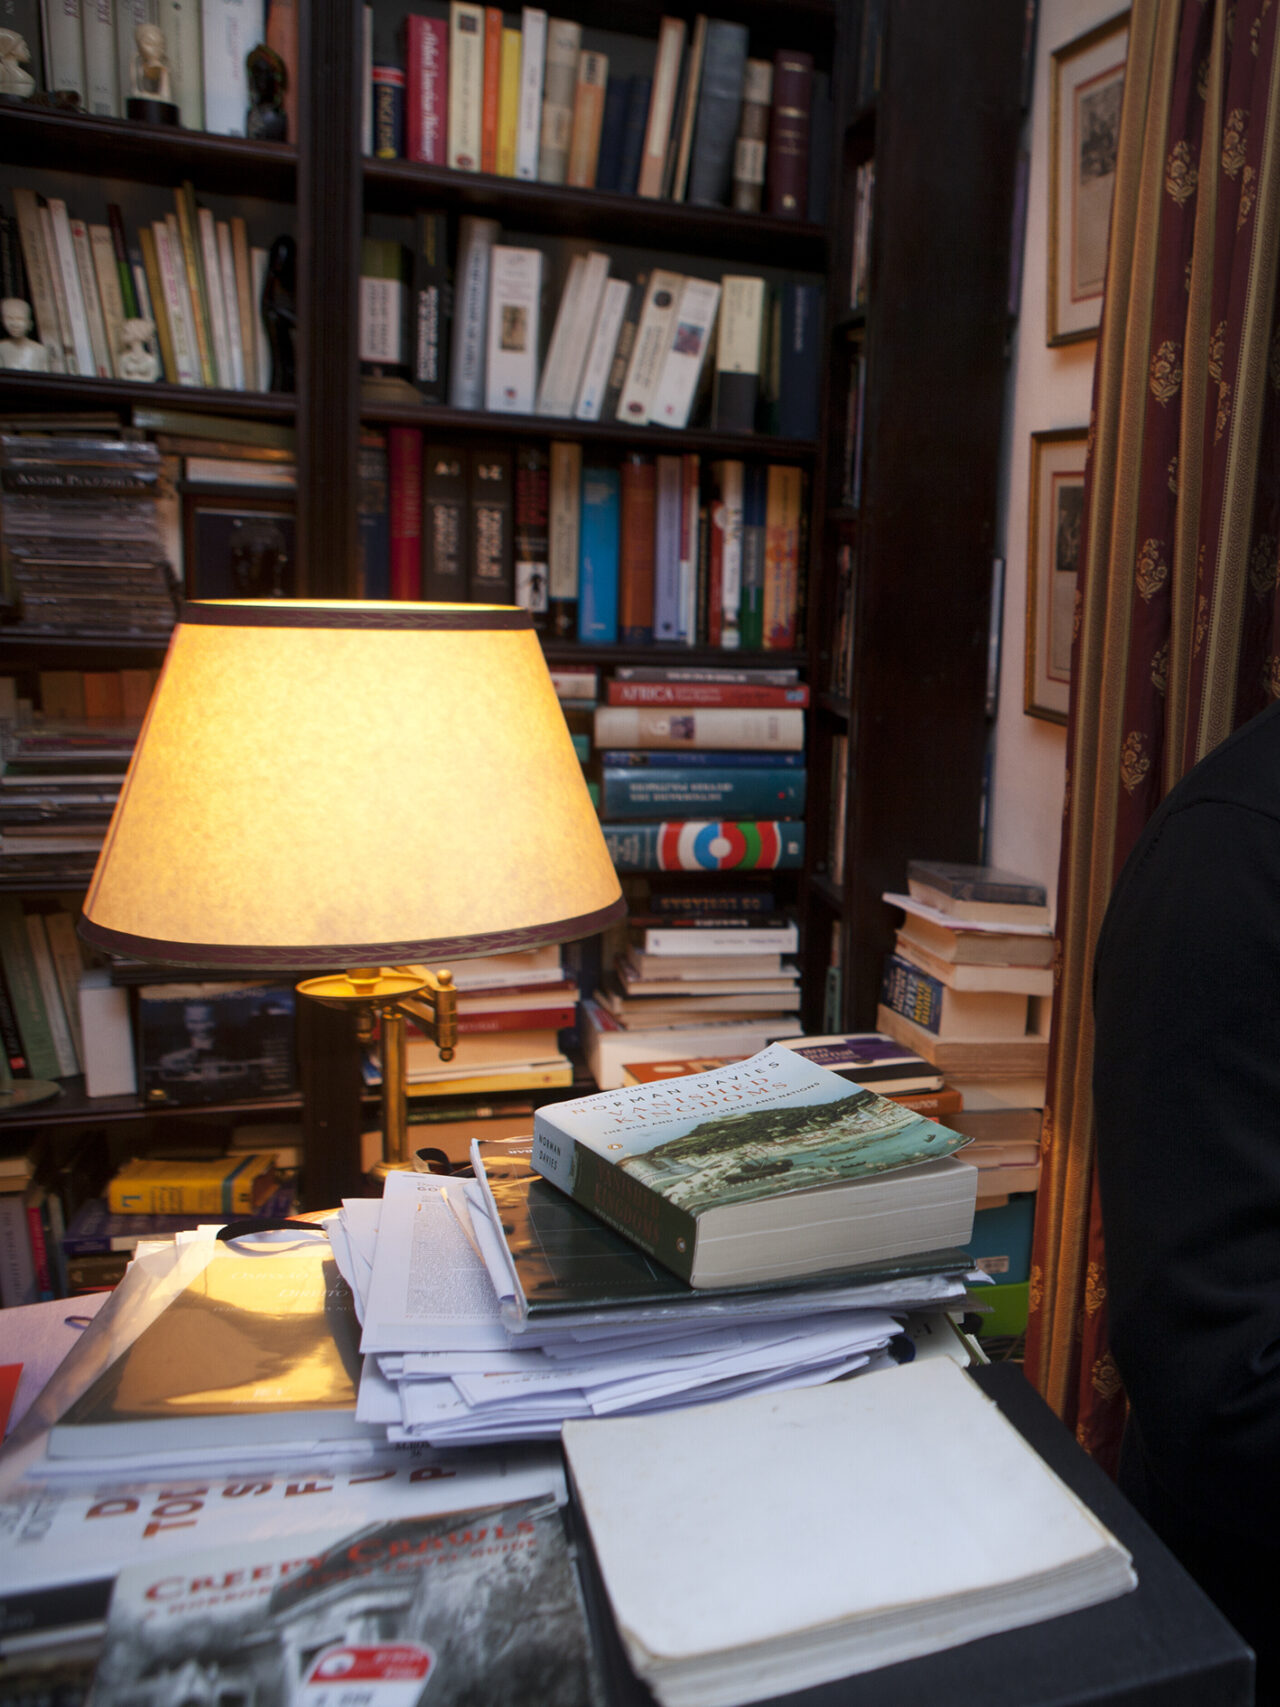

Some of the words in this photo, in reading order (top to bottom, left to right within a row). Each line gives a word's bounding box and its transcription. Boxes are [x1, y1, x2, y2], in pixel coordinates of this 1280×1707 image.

[620, 682, 674, 700] AFRICA
[571, 1087, 682, 1115] NORMAN
[697, 1062, 780, 1089] DAVIES
[607, 1078, 769, 1117] VANISHED
[613, 1081, 788, 1124] KINGDOMS
[720, 1103, 753, 1114] STATES
[778, 1081, 821, 1098] NATIONS
[538, 1134, 562, 1157] NORMAN
[538, 1150, 559, 1171] DAVIES
[145, 1550, 331, 1601] CREEPY
[346, 1520, 536, 1564] CRAWLS
[470, 1537, 539, 1558] GUIDE
